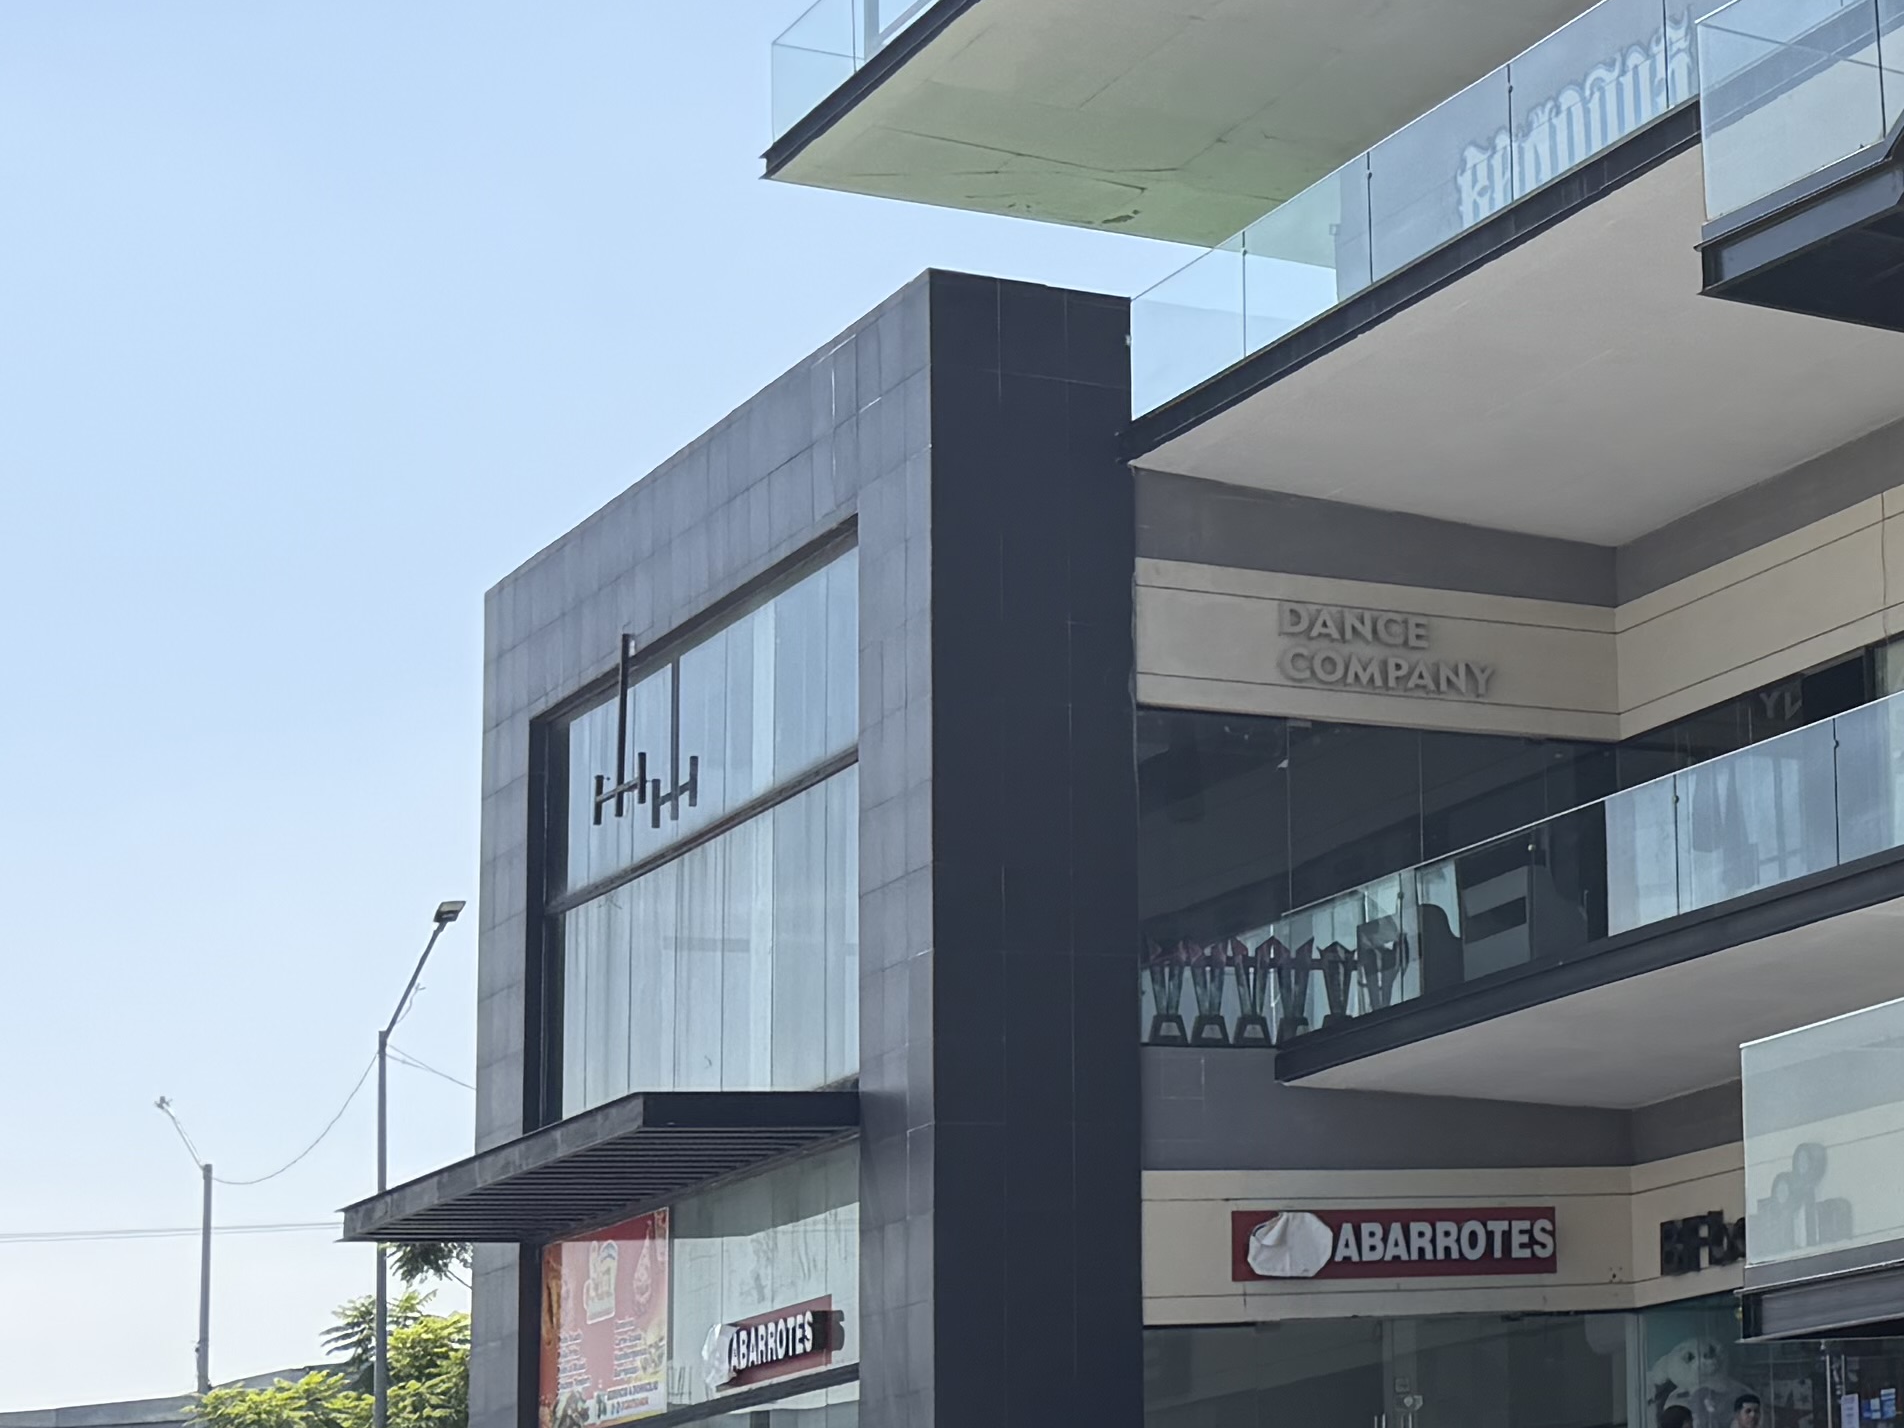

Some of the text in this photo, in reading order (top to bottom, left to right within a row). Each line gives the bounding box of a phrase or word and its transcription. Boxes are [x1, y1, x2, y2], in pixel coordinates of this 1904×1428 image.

[1279, 603, 1430, 650] DANCE
[1280, 647, 1494, 696] COMPANY
[1335, 1220, 1555, 1263] ABARROTES
[730, 1310, 813, 1373] ABARROTES
